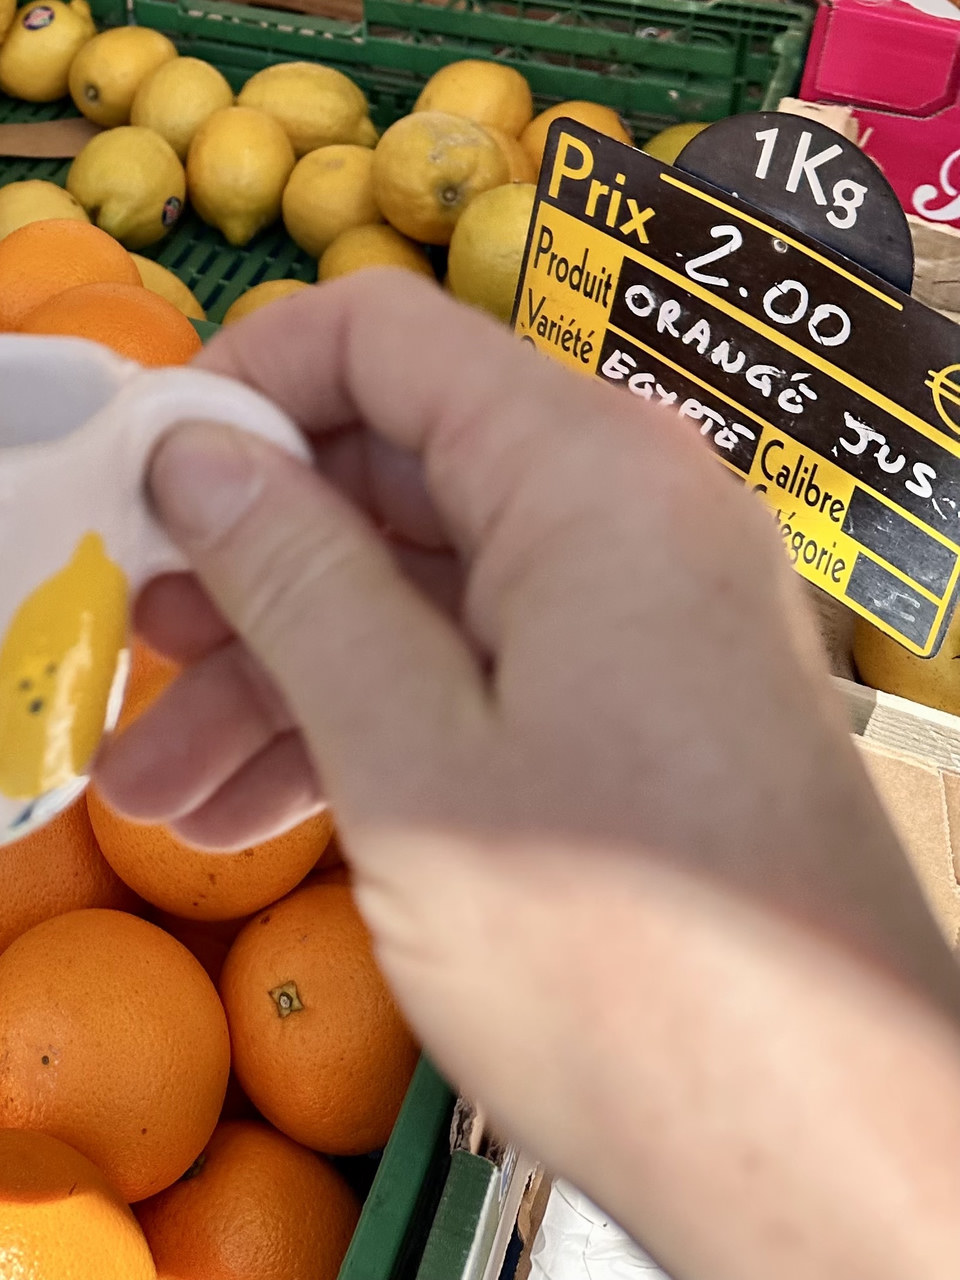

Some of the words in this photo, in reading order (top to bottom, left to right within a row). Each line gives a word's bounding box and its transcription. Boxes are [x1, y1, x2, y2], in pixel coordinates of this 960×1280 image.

[533, 224, 613, 309] Produit
[548, 132, 656, 245] Prix
[685, 224, 852, 347] 2.00
[527, 287, 595, 365] Variété
[760, 438, 846, 523] Calibre
[753, 483, 846, 584] égorie
